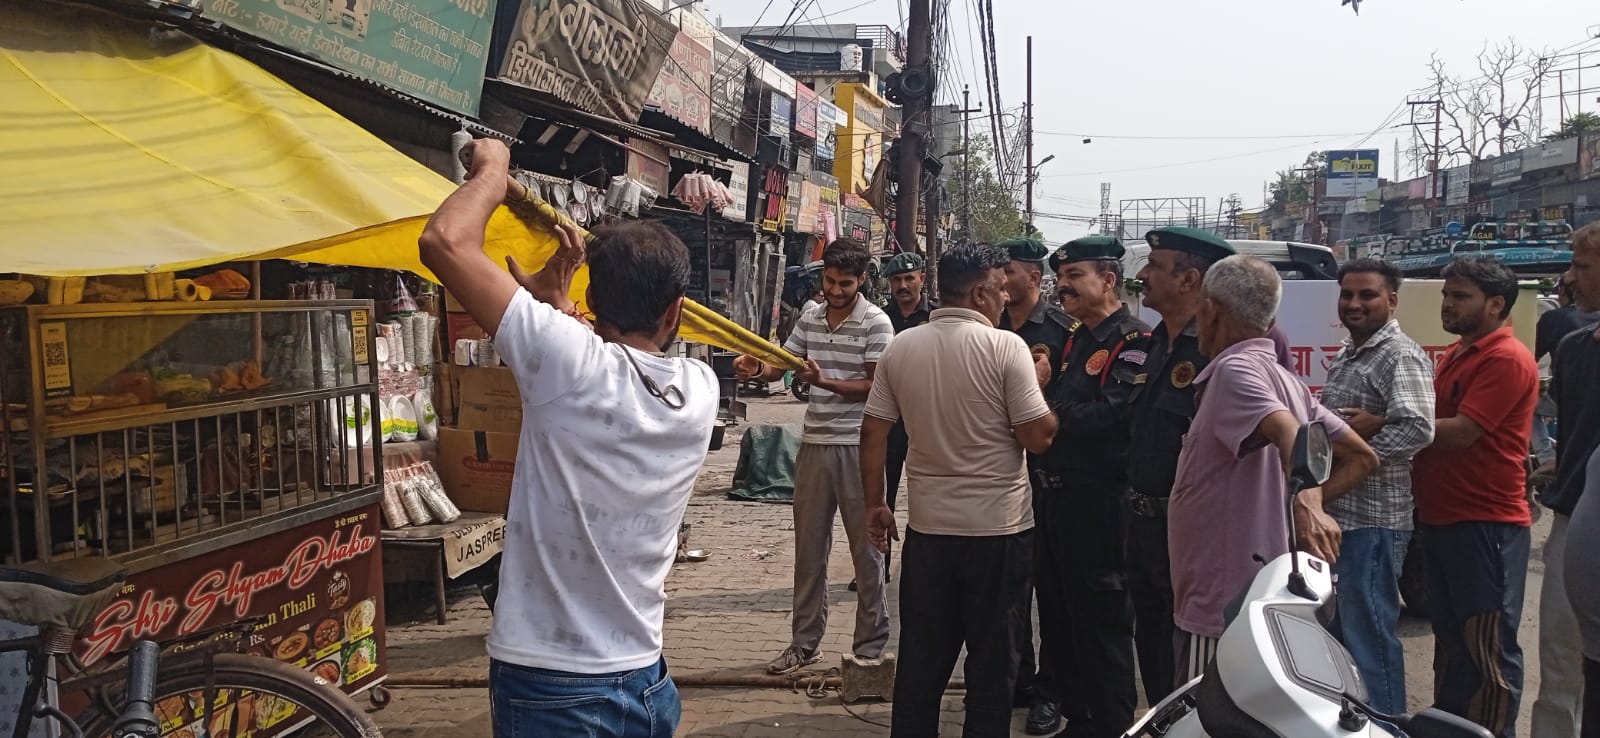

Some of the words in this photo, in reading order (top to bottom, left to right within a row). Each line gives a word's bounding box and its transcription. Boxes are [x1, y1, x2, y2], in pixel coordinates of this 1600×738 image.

[256, 12, 288, 37] हमारे
[289, 25, 312, 47] यहाँ
[360, 53, 376, 72] का
[376, 58, 398, 79] सभी
[399, 68, 427, 91] सामान
[560, 2, 648, 81] बालाजी
[82, 590, 176, 665] Shri
[179, 562, 287, 636] Shyam
[286, 525, 377, 588] Dhaba
[280, 593, 316, 620] Thali
